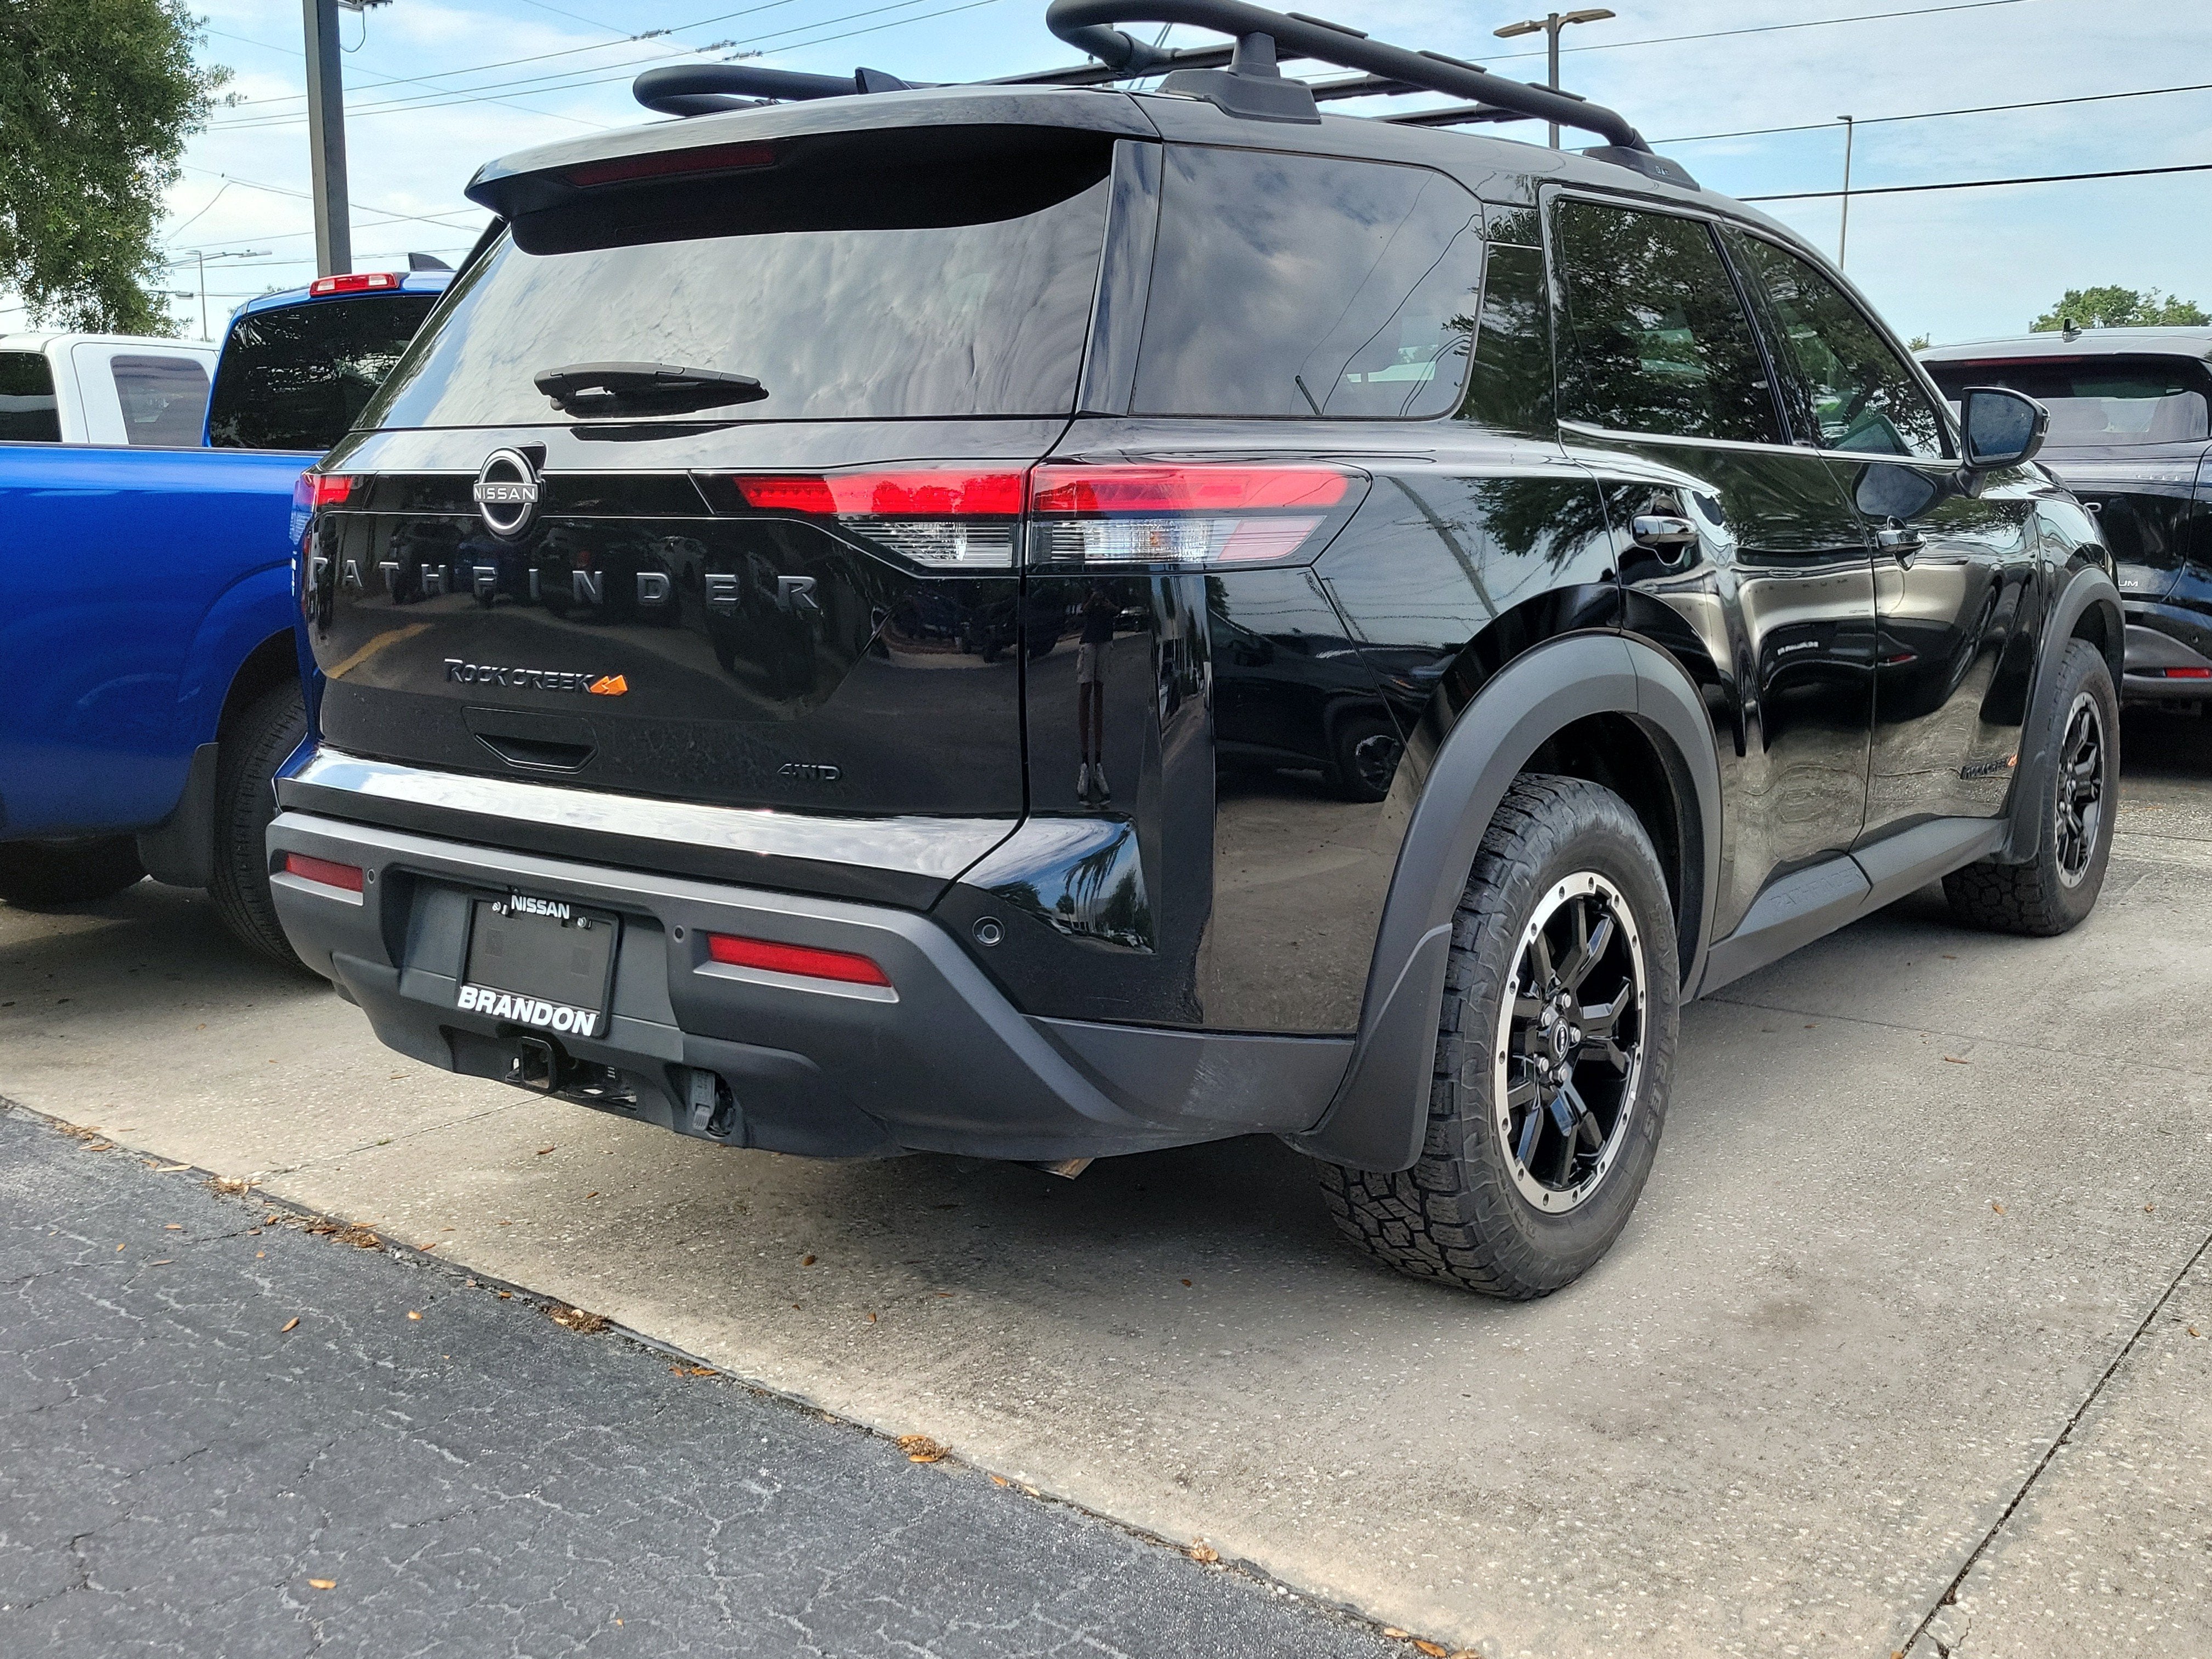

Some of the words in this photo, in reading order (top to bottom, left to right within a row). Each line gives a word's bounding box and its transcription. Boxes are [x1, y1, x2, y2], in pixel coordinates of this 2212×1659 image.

[474, 487, 535, 500] NISSAN
[312, 556, 819, 610] PATHFINDER
[444, 658, 509, 686] ROCK
[511, 669, 595, 693] CREEK
[776, 763, 842, 780] 4WD
[511, 895, 570, 919] NISSAN
[457, 985, 596, 1036] BRANDON
[1643, 1013, 1672, 1140] TIRES
